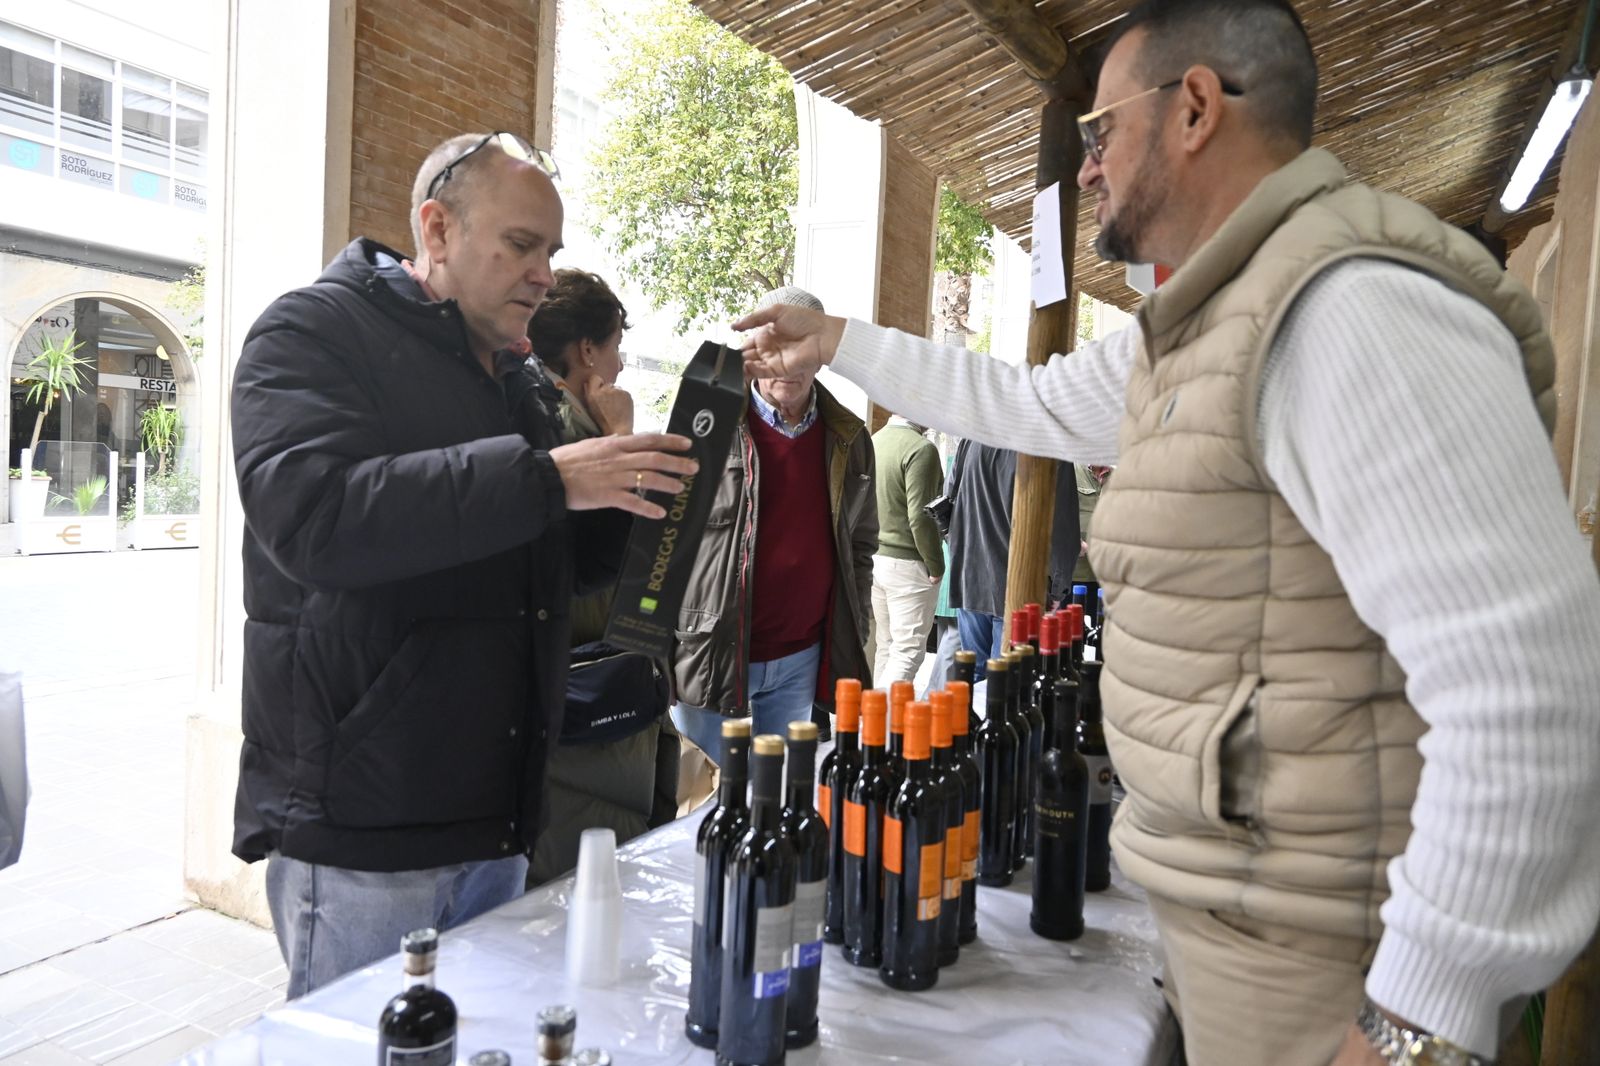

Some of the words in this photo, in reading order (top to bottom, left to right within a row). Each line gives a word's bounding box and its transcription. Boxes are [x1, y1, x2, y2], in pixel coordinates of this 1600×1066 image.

[61, 154, 87, 167] SOTO
[174, 185, 197, 196] SOTO
[647, 526, 679, 592] BODEGAS
[618, 710, 637, 720] LOLA
